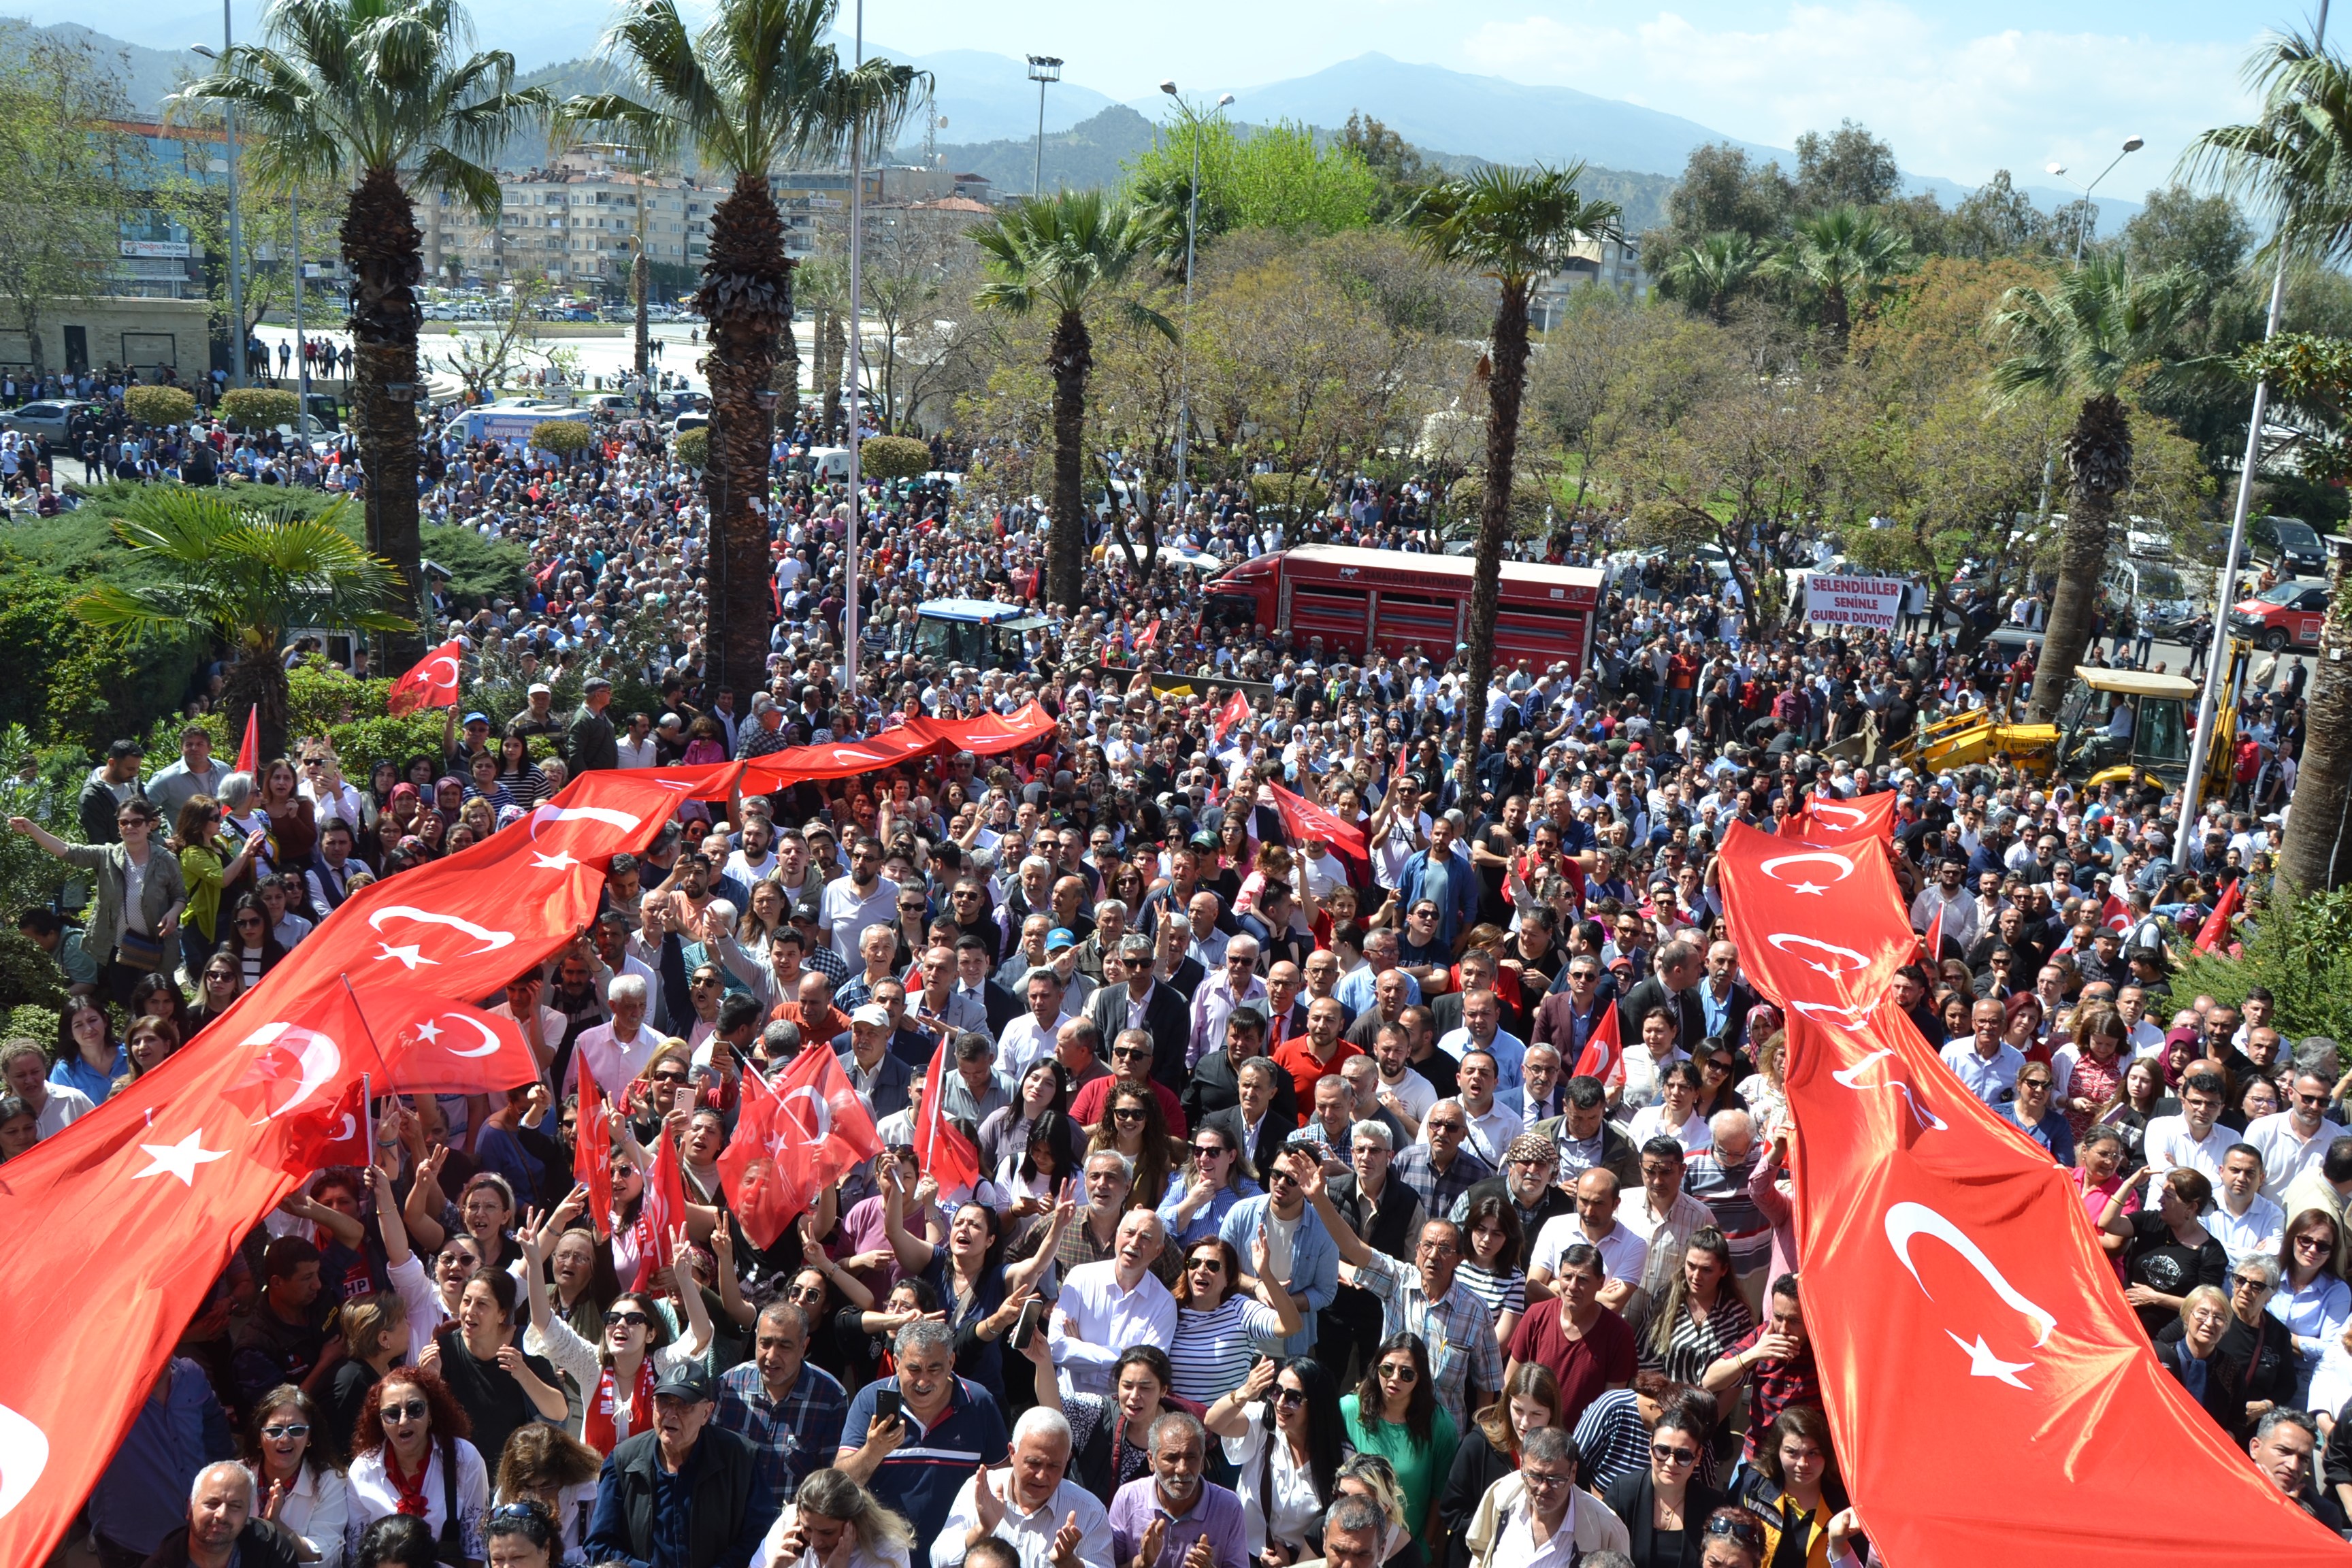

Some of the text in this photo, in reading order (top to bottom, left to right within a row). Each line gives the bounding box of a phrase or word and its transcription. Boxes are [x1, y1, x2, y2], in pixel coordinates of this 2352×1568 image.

[484, 426, 533, 437] HAYBULA
[1420, 575, 1472, 588] HAYVANCILI
[1812, 578, 1898, 596] SELENDİLİLER
[1834, 595, 1878, 610] SENİNLE
[1810, 610, 1894, 626] GURUR DUYUYO
[344, 1280, 366, 1296] HP
